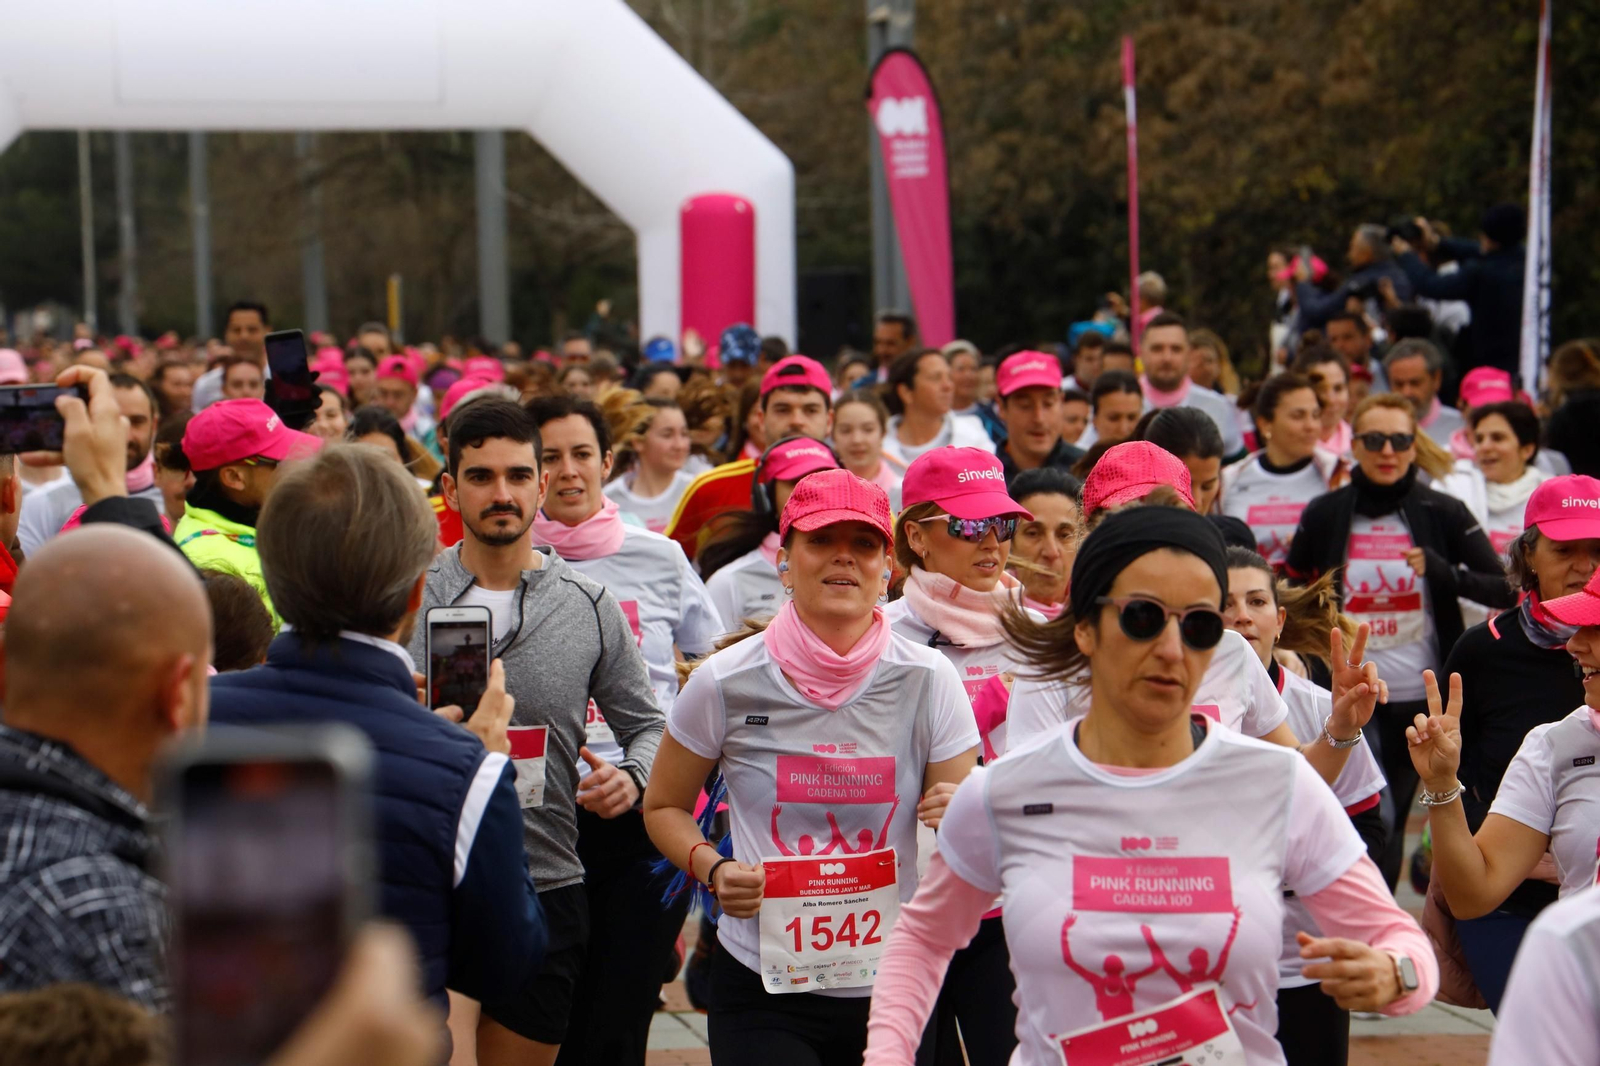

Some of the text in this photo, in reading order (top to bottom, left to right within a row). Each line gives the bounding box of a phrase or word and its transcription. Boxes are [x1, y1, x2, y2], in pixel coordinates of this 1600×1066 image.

[816, 763, 856, 773] X Edición
[790, 773, 883, 786] PINK RUNNING
[807, 788, 866, 798] CADENA 100
[1125, 864, 1178, 876] X Edición
[808, 876, 859, 887] PINK RUNNING
[1090, 876, 1215, 891] PINK RUNNING
[825, 886, 840, 895] DÍAS
[844, 897, 869, 905] Sánchez
[1112, 893, 1193, 906] CADENA 100
[785, 909, 882, 953] 1542
